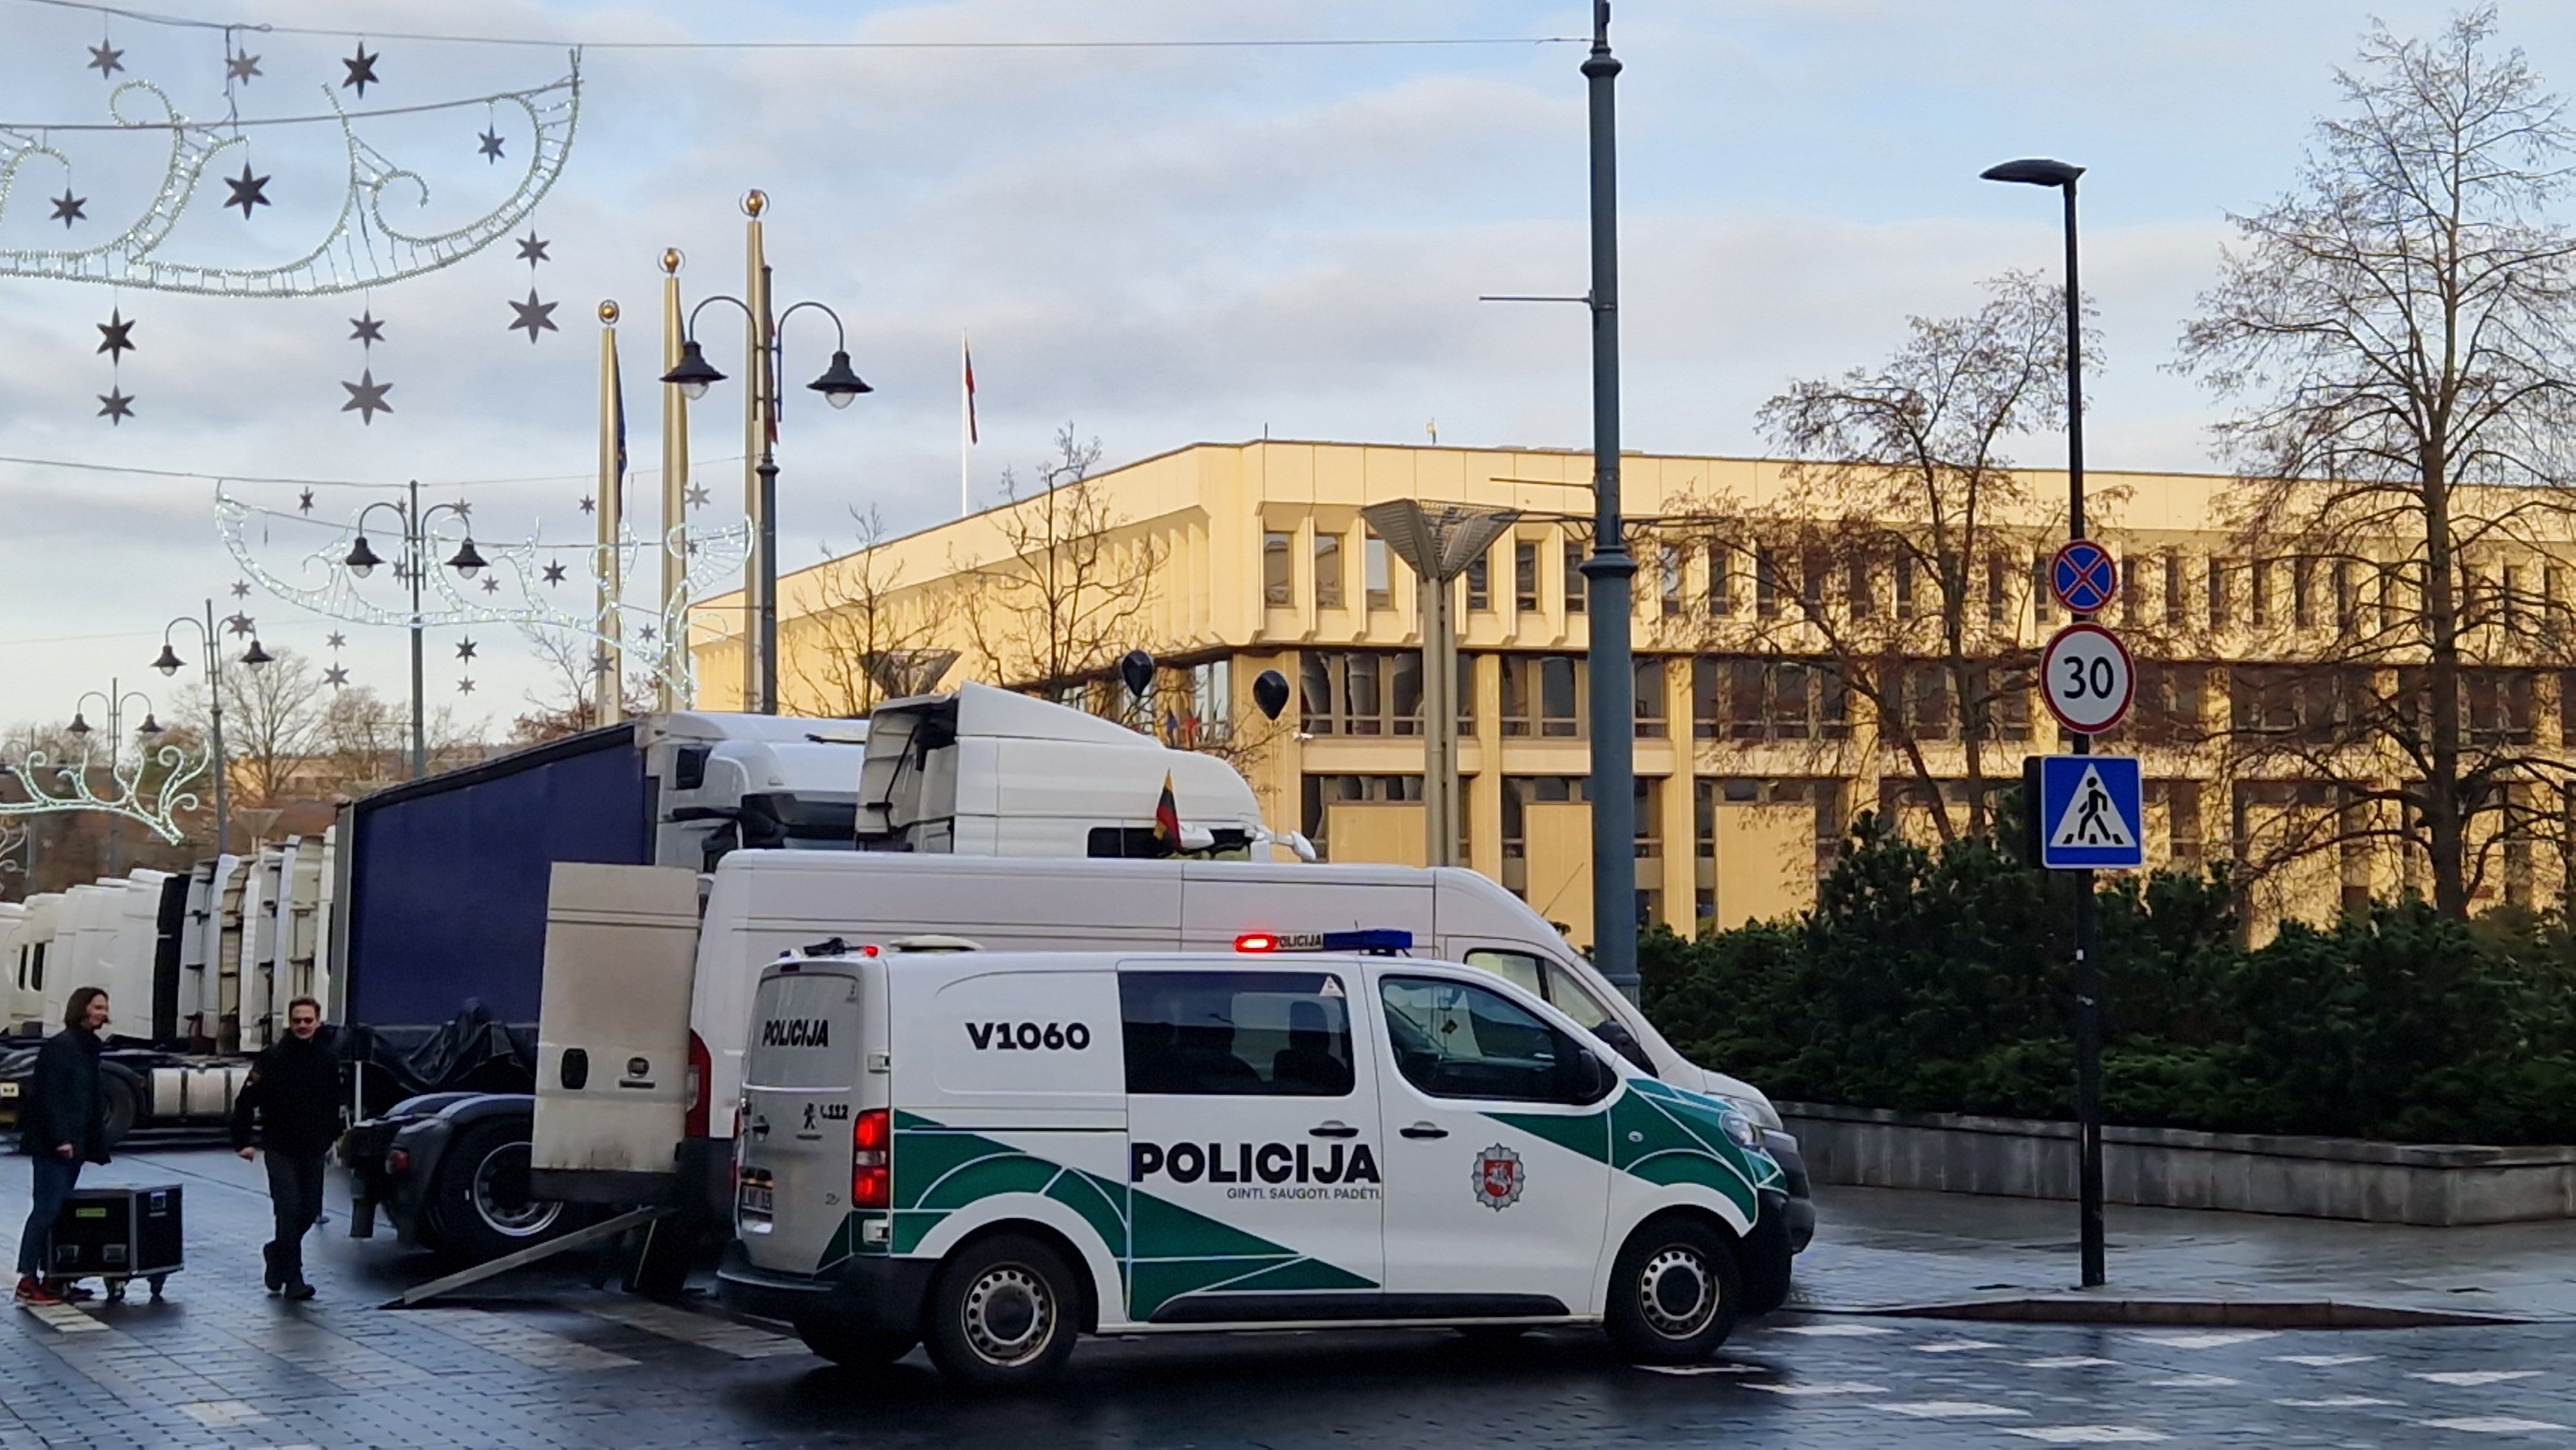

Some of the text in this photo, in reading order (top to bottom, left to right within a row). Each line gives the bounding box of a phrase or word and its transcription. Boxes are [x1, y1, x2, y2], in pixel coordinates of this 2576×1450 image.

[2063, 656, 2114, 699] 30
[1273, 934, 1322, 947] POLICIJA
[761, 1018, 829, 1048] POLICIJA
[965, 1022, 1091, 1051] V1060
[828, 1104, 848, 1120] 112
[1131, 1142, 1381, 1183] POLICIJA
